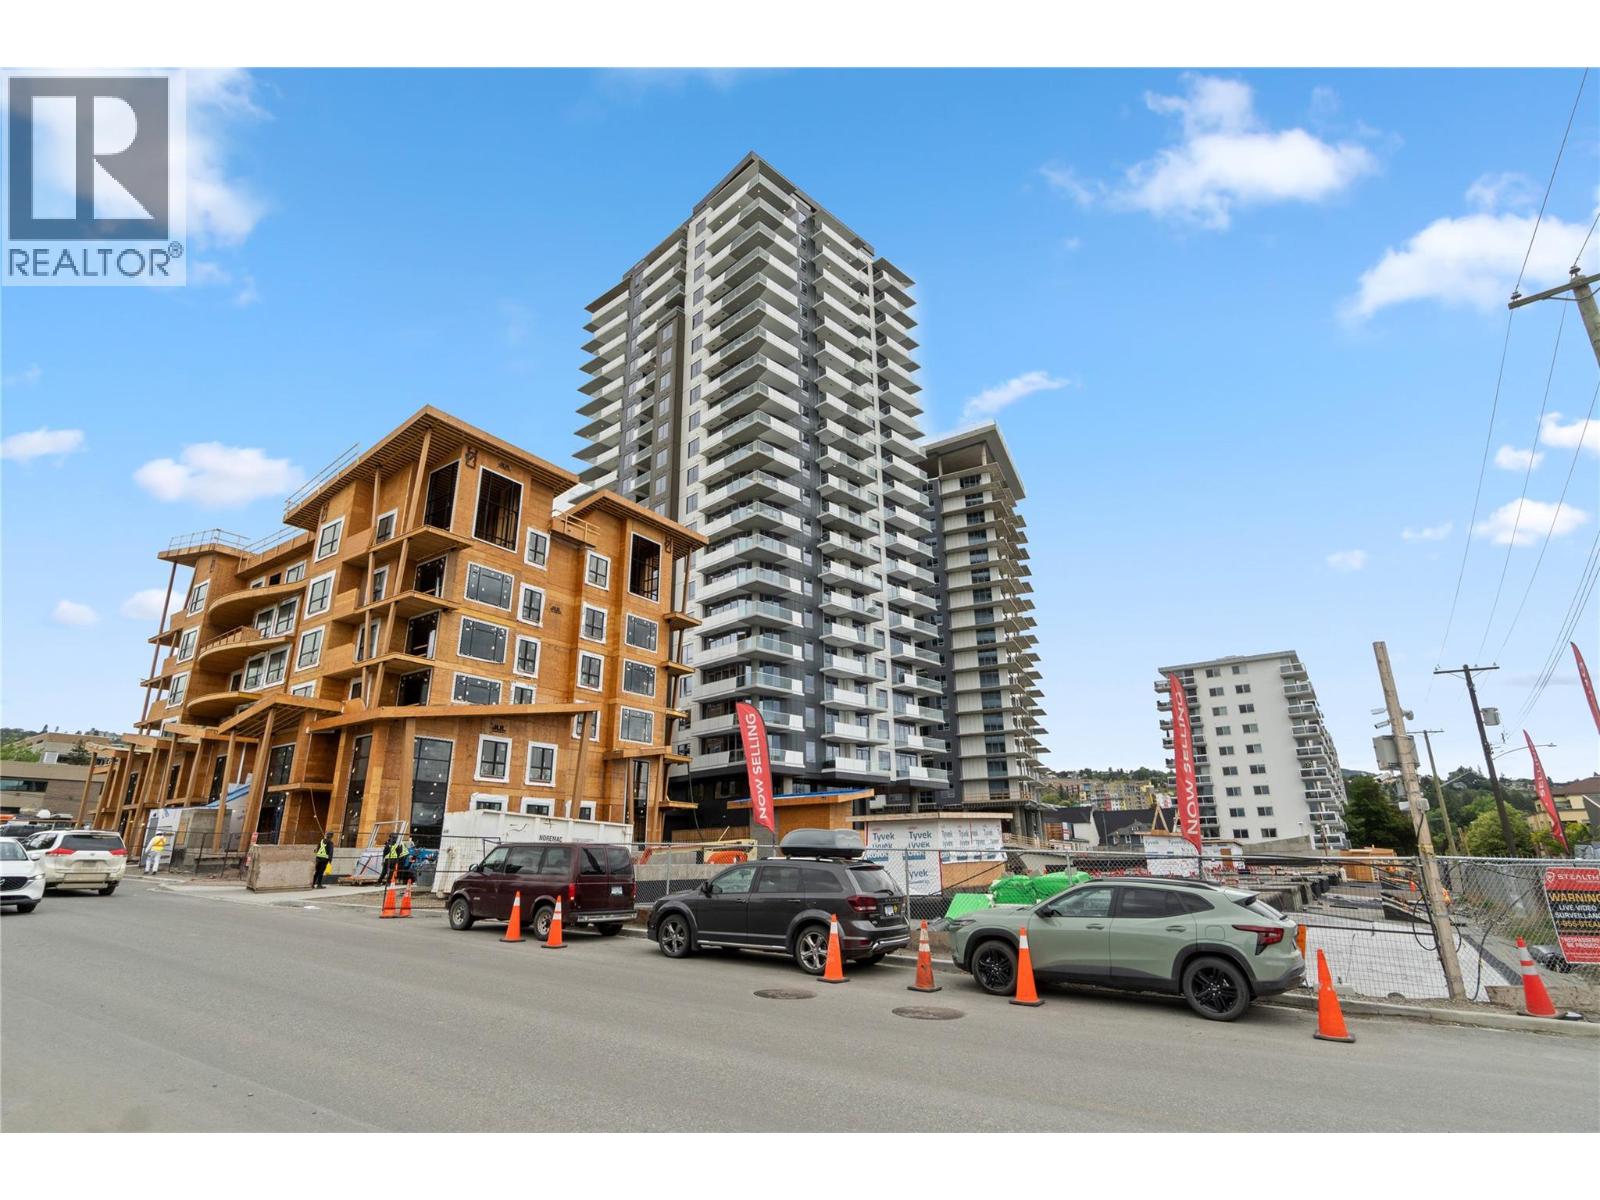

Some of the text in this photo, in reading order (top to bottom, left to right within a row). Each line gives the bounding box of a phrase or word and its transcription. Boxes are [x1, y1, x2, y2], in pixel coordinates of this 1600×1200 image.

[745, 713, 768, 819] NOW SELLING
[1175, 692, 1199, 835] NOW SELLING
[872, 830, 932, 842] Tyvek Tyvek
[908, 869, 929, 880] yvek
[1557, 873, 1599, 881] STEALTH
[1576, 904, 1597, 912] VIDEO
